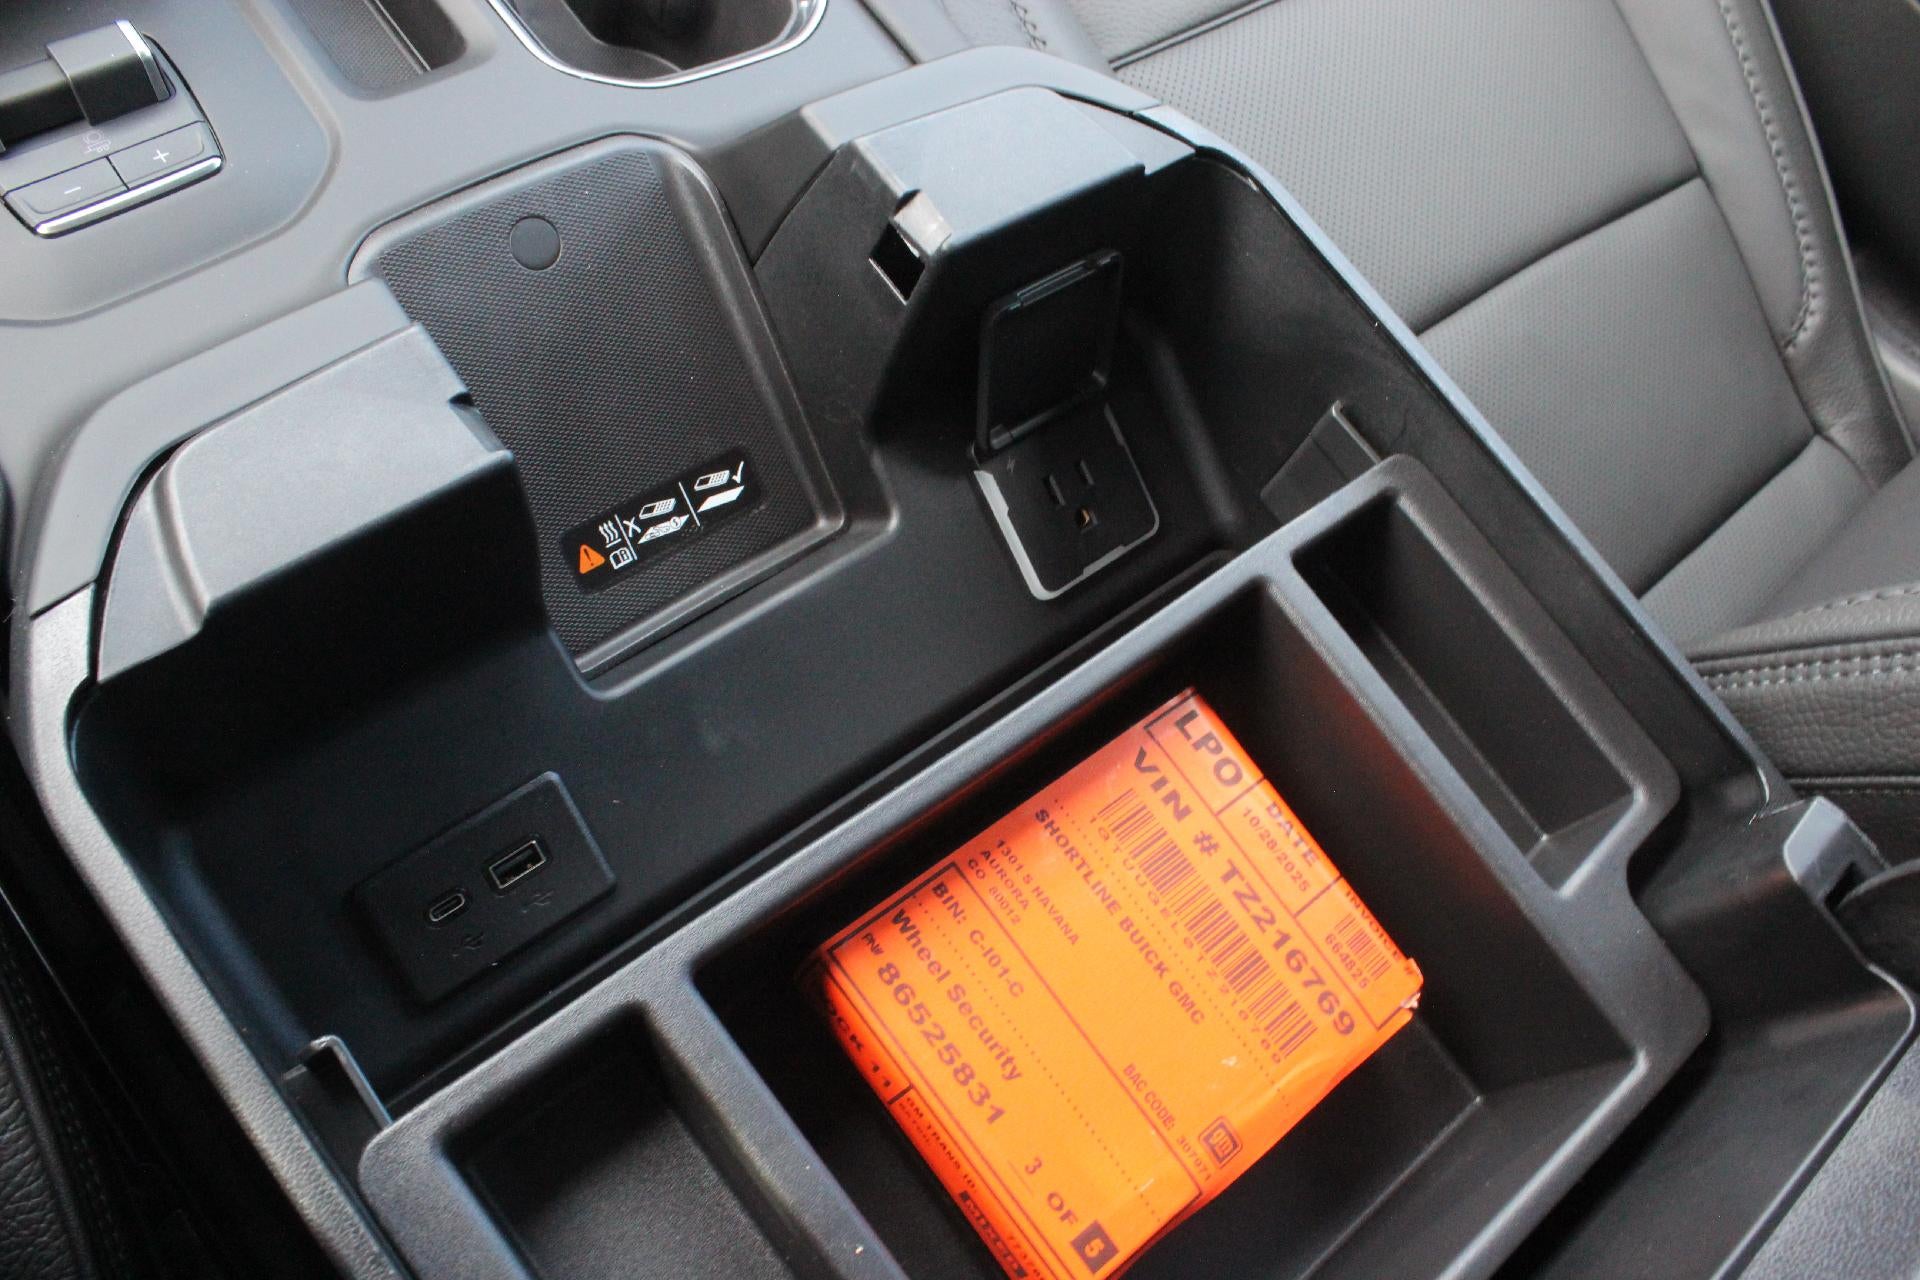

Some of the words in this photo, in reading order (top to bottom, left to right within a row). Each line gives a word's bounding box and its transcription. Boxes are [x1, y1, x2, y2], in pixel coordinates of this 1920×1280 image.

[1172, 708, 1243, 787] LPO
[1242, 808, 1310, 892] 10/28/2025
[1264, 799, 1319, 868] DATE
[931, 880, 966, 924] BIN:
[967, 857, 986, 880] CO
[988, 885, 1021, 925] 80012
[979, 849, 1029, 910] AURORA
[996, 839, 1024, 871] 1301
[1022, 872, 1033, 884] S
[1030, 885, 1079, 945] HAVANA
[1034, 808, 1121, 916] SHORTLINE
[1118, 915, 1169, 980] BUICK
[1167, 979, 1205, 1024] GMC
[1133, 745, 1193, 822] VIN
[1189, 826, 1223, 861] #
[1219, 857, 1355, 1036] TZ216769
[891, 906, 951, 983] Wheel
[946, 983, 1023, 1082] Security
[1324, 932, 1370, 989] 664825
[876, 961, 1006, 1125] 86525831
[1122, 1062, 1148, 1092] BAC
[1143, 1089, 1175, 1131] CODE:
[1045, 1191, 1078, 1224] OF
